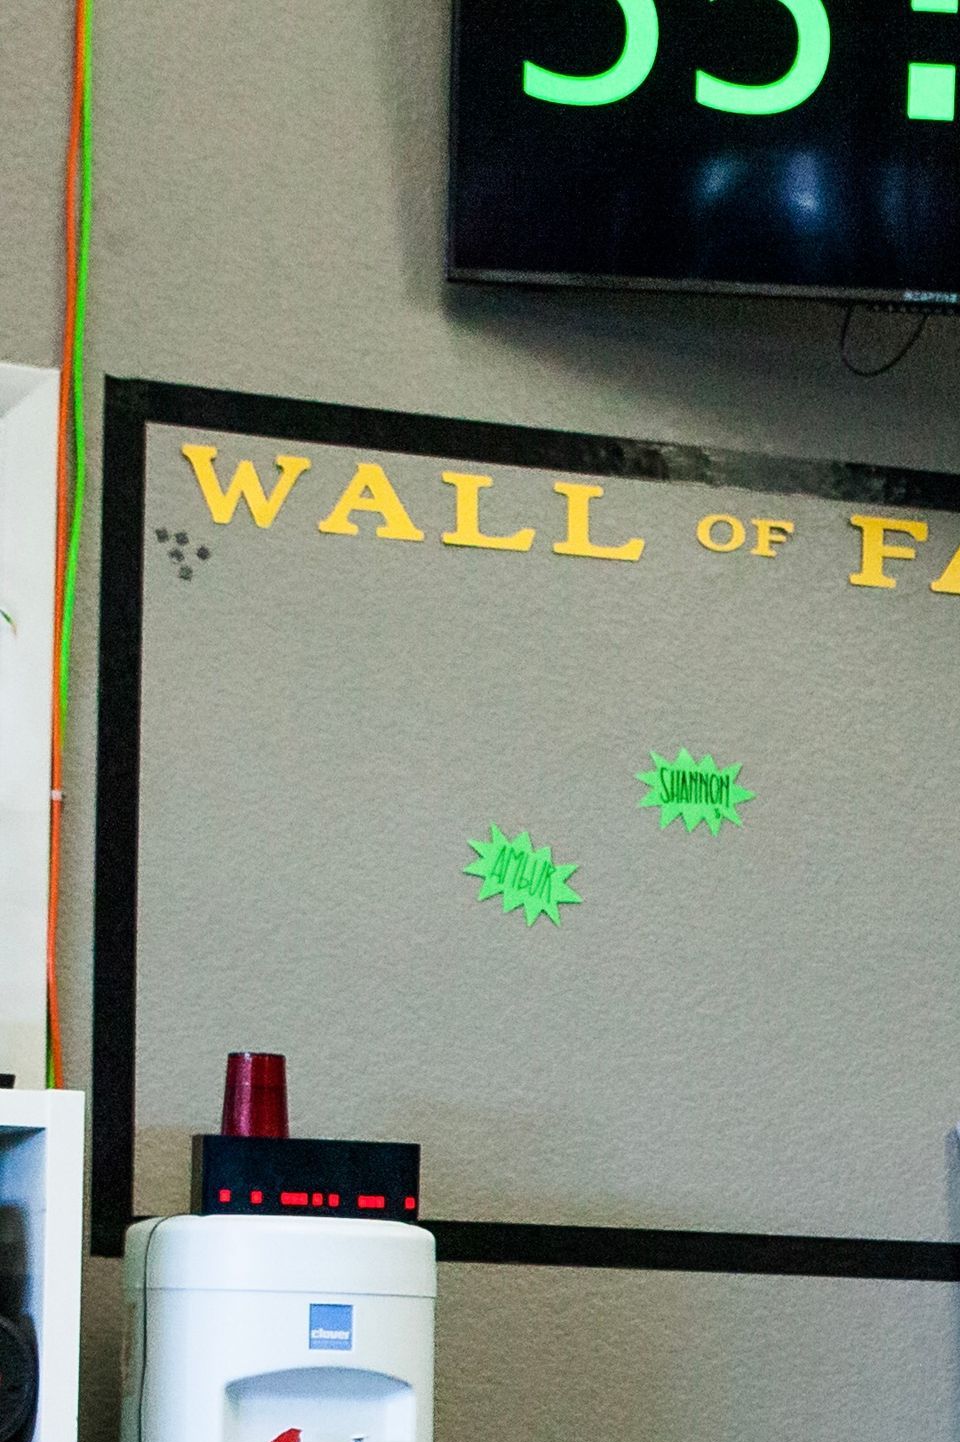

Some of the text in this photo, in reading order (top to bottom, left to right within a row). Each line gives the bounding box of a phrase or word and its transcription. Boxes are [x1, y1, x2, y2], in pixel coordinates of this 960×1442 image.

[181, 445, 645, 562] WALL
[697, 513, 794, 560] OF
[659, 766, 730, 808] SHANNON
